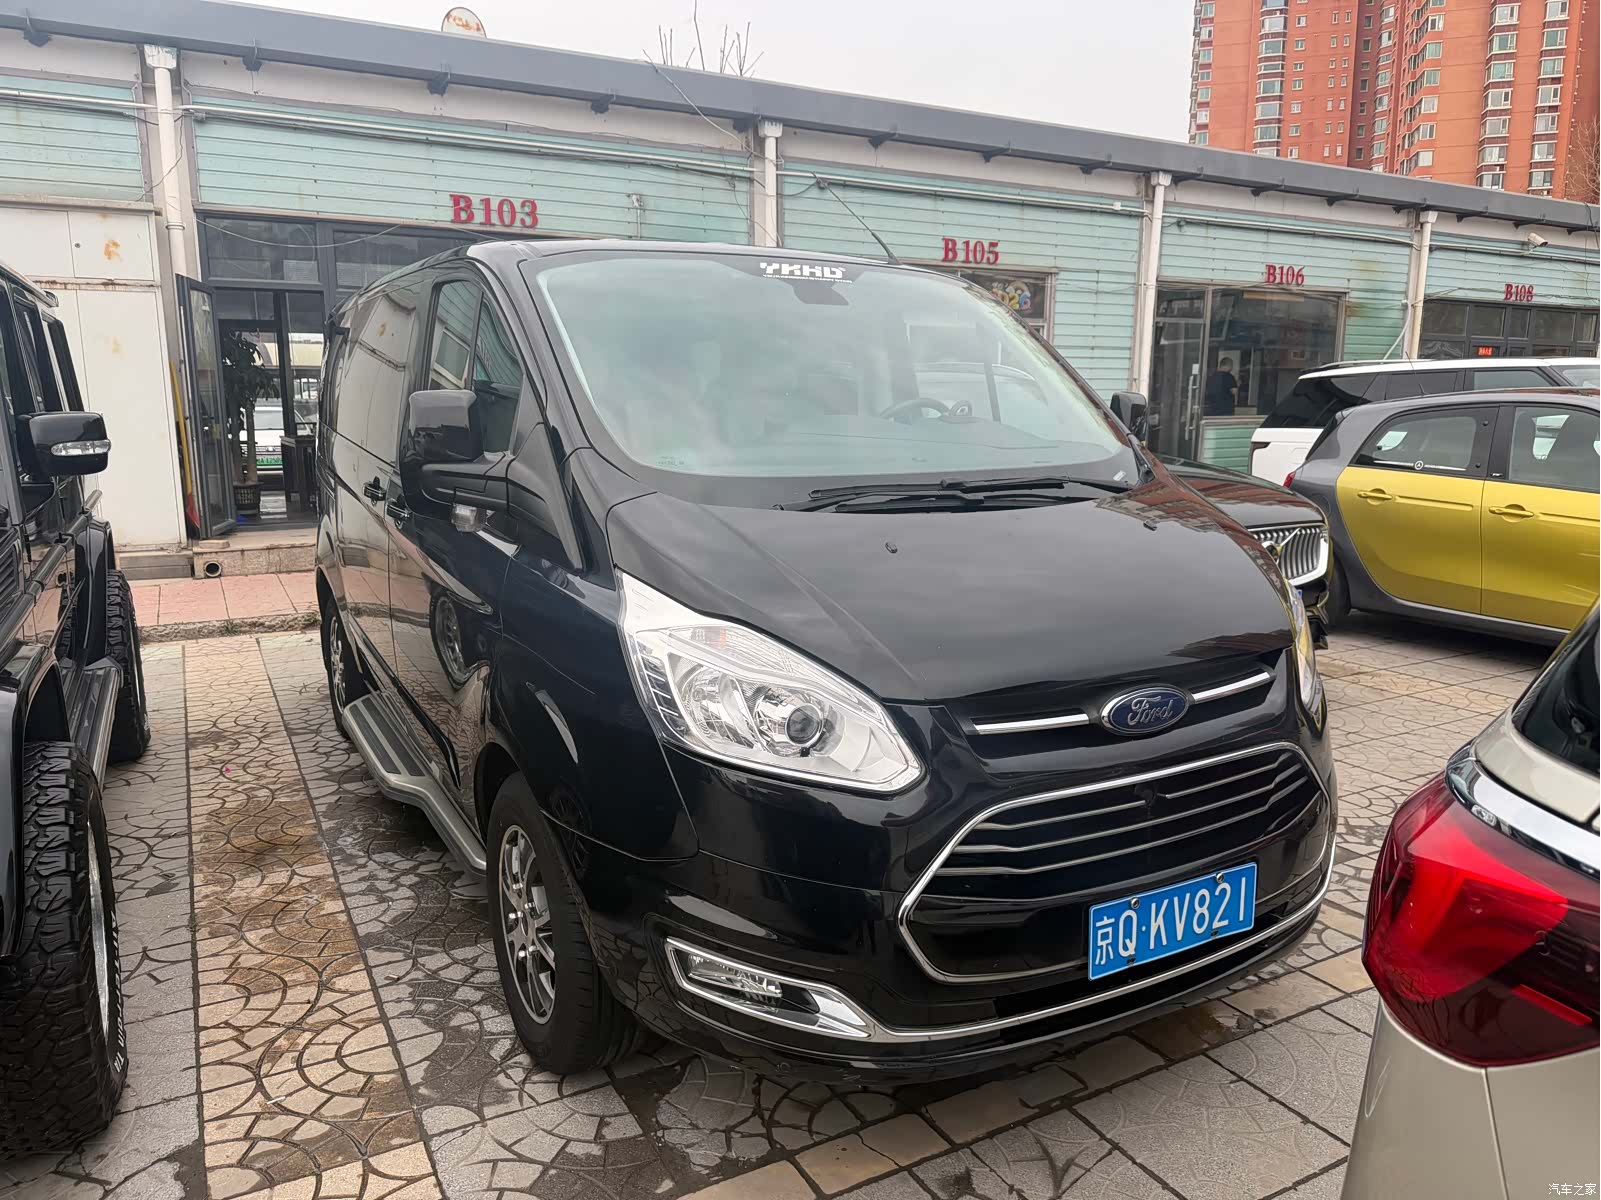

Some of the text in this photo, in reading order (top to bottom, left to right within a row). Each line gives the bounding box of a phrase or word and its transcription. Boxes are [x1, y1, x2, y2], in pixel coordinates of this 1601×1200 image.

[449, 193, 538, 228] B103
[942, 237, 1000, 265] B105
[1265, 264, 1305, 287] B106
[1504, 283, 1534, 302] B108
[1127, 695, 1174, 726] Ford
